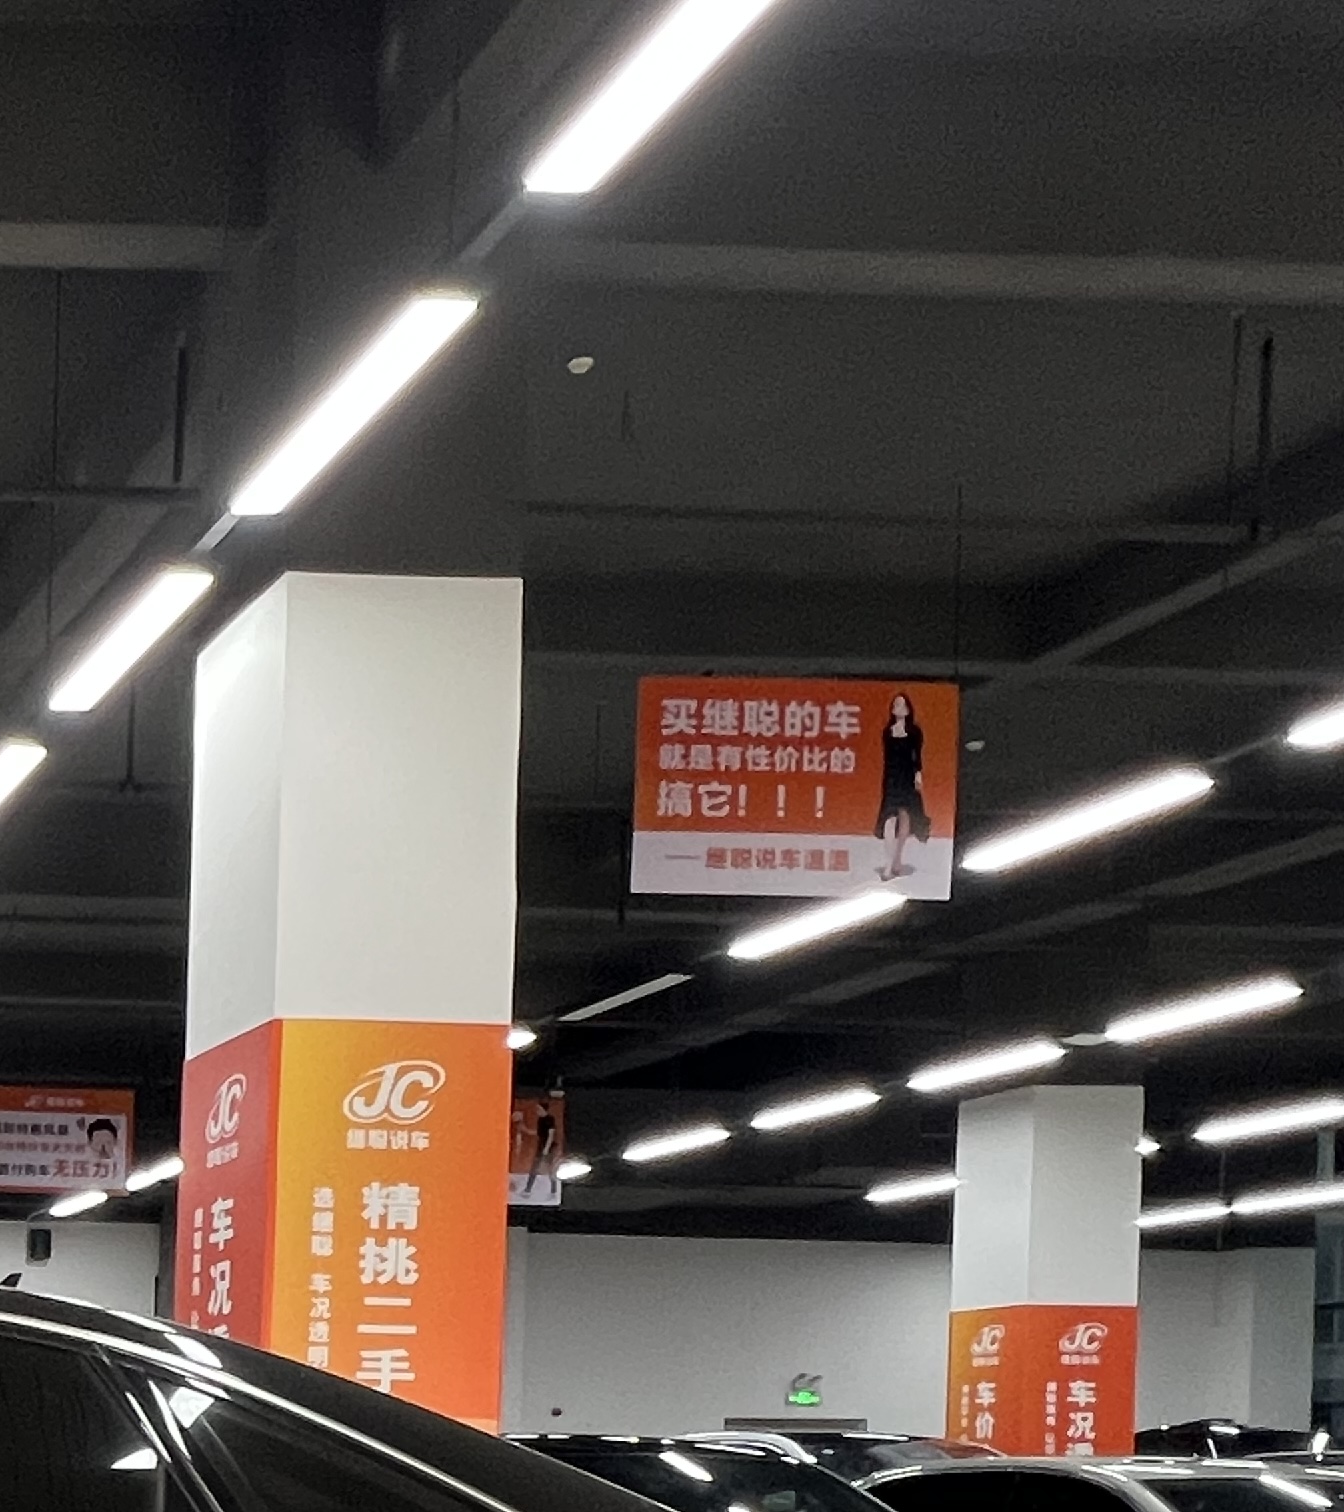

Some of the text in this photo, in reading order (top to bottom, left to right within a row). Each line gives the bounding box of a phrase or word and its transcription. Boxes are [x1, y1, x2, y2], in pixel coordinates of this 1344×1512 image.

[661, 698, 861, 739] 买继聪的车
[659, 744, 856, 773] 就是有性价比的
[346, 1062, 441, 1122] JC
[356, 1182, 420, 1393] 精挑二手
[1059, 1323, 1108, 1353] JC
